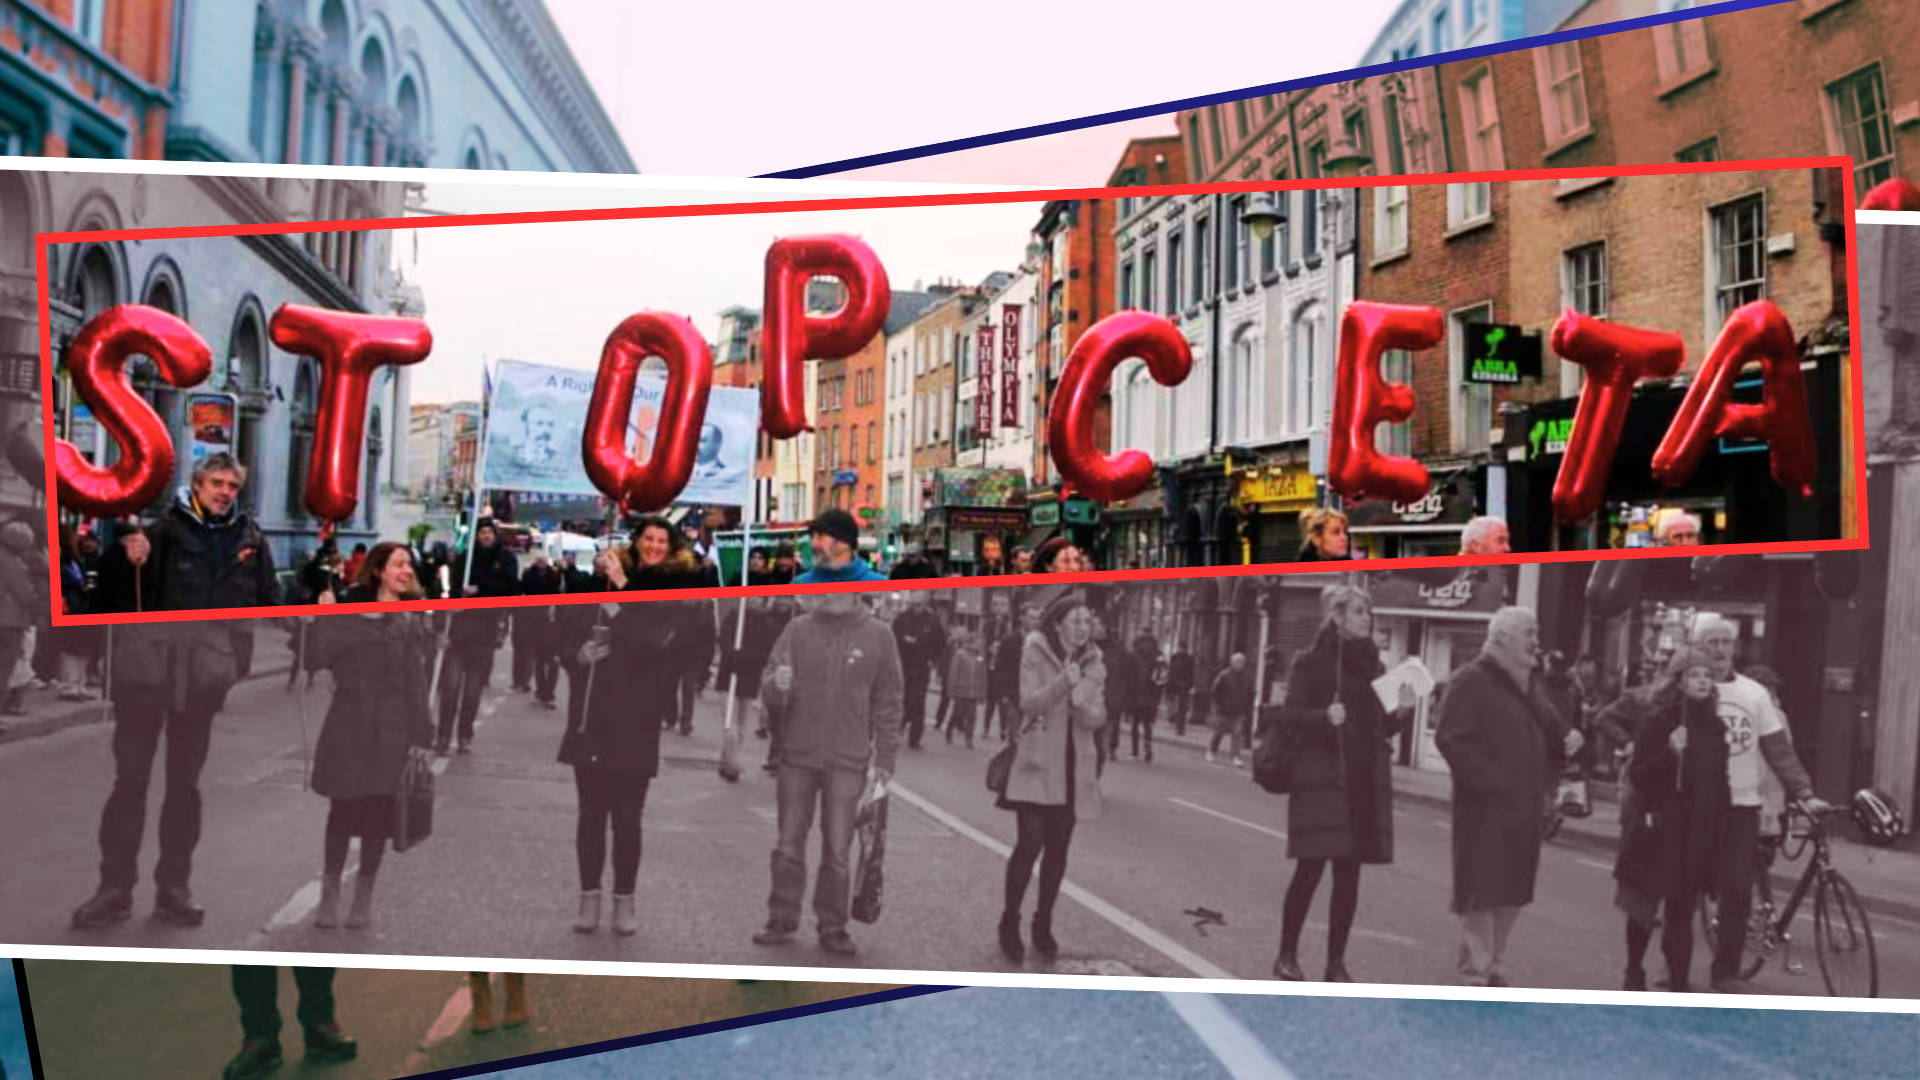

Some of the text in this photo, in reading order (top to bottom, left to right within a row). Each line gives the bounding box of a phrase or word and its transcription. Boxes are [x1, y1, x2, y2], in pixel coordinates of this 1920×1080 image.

[55, 233, 1816, 523] STOP CETA
[546, 374, 557, 388] A
[979, 332, 993, 432] THEATRE
[1003, 310, 1017, 420] OLYMPIA
